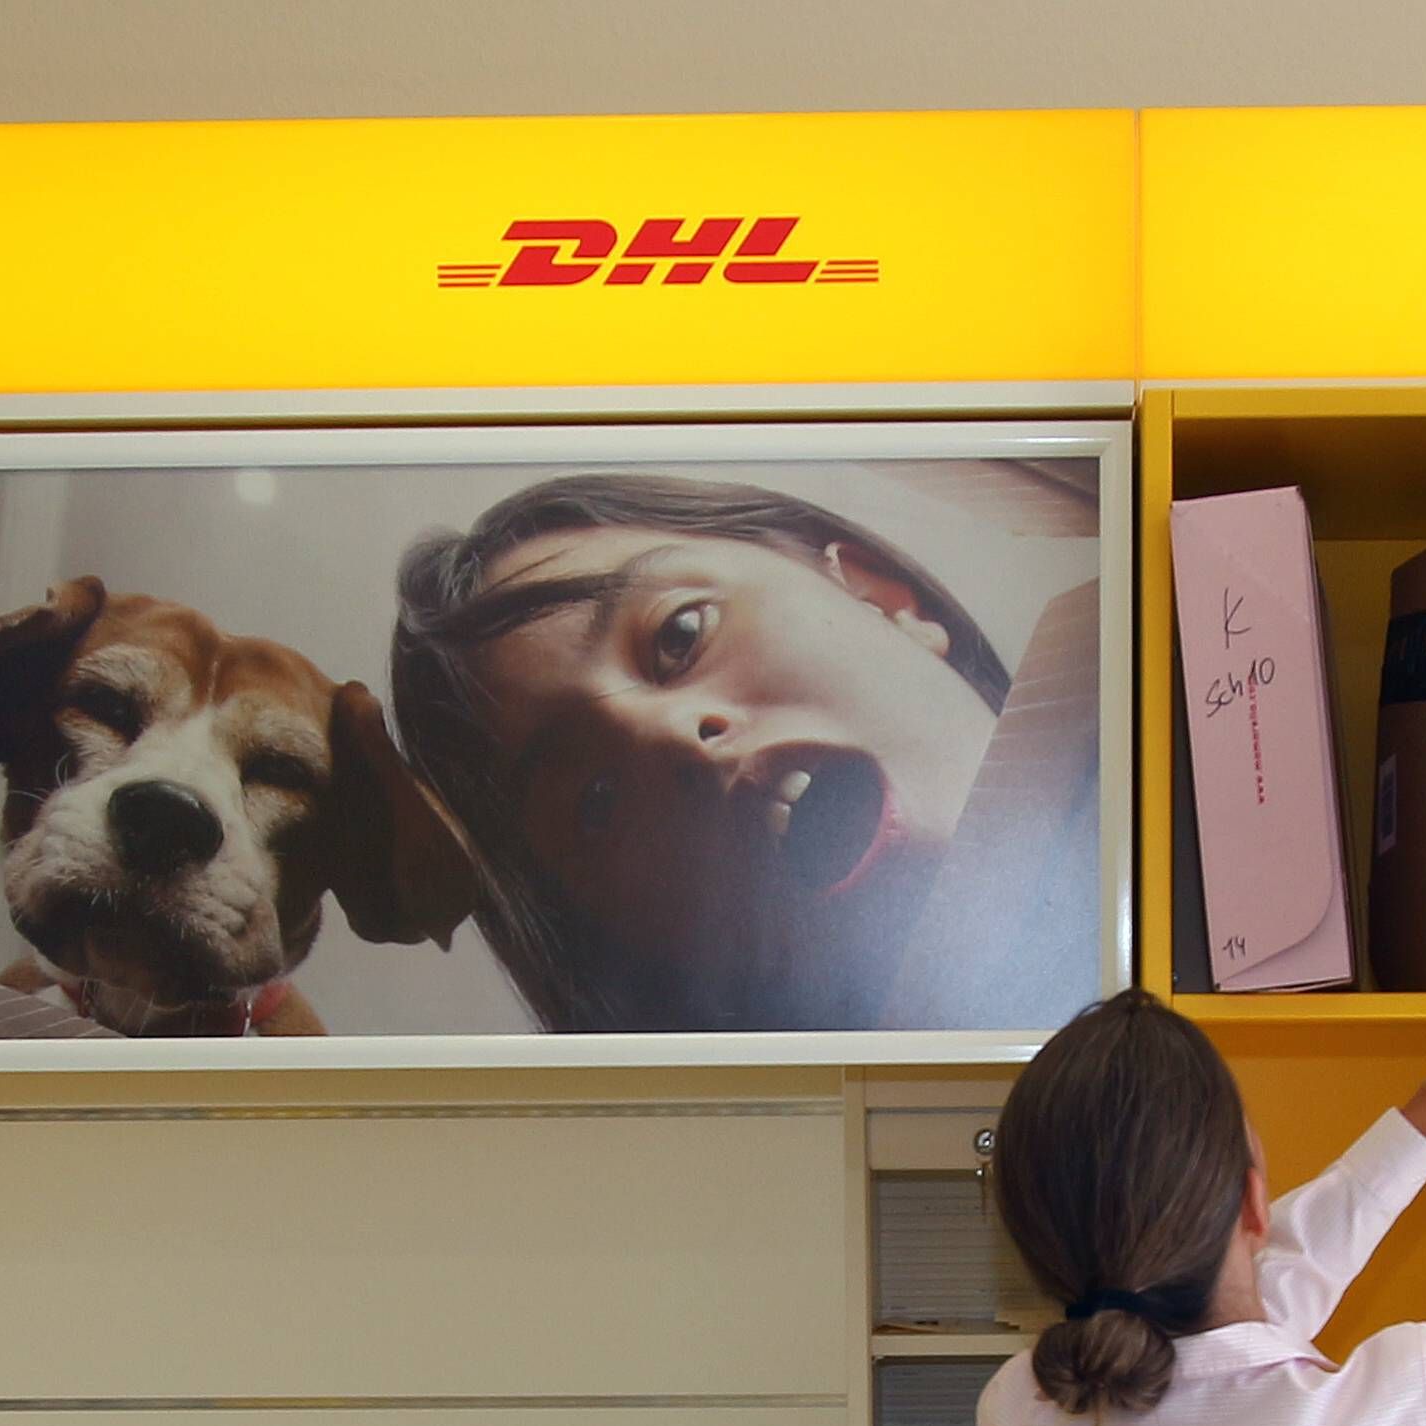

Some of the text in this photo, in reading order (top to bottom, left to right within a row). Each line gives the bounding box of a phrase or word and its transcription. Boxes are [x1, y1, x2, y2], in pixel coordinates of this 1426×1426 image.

[497, 217, 820, 287] DHL
[1222, 588, 1252, 649] K
[1222, 935, 1246, 958] 14
